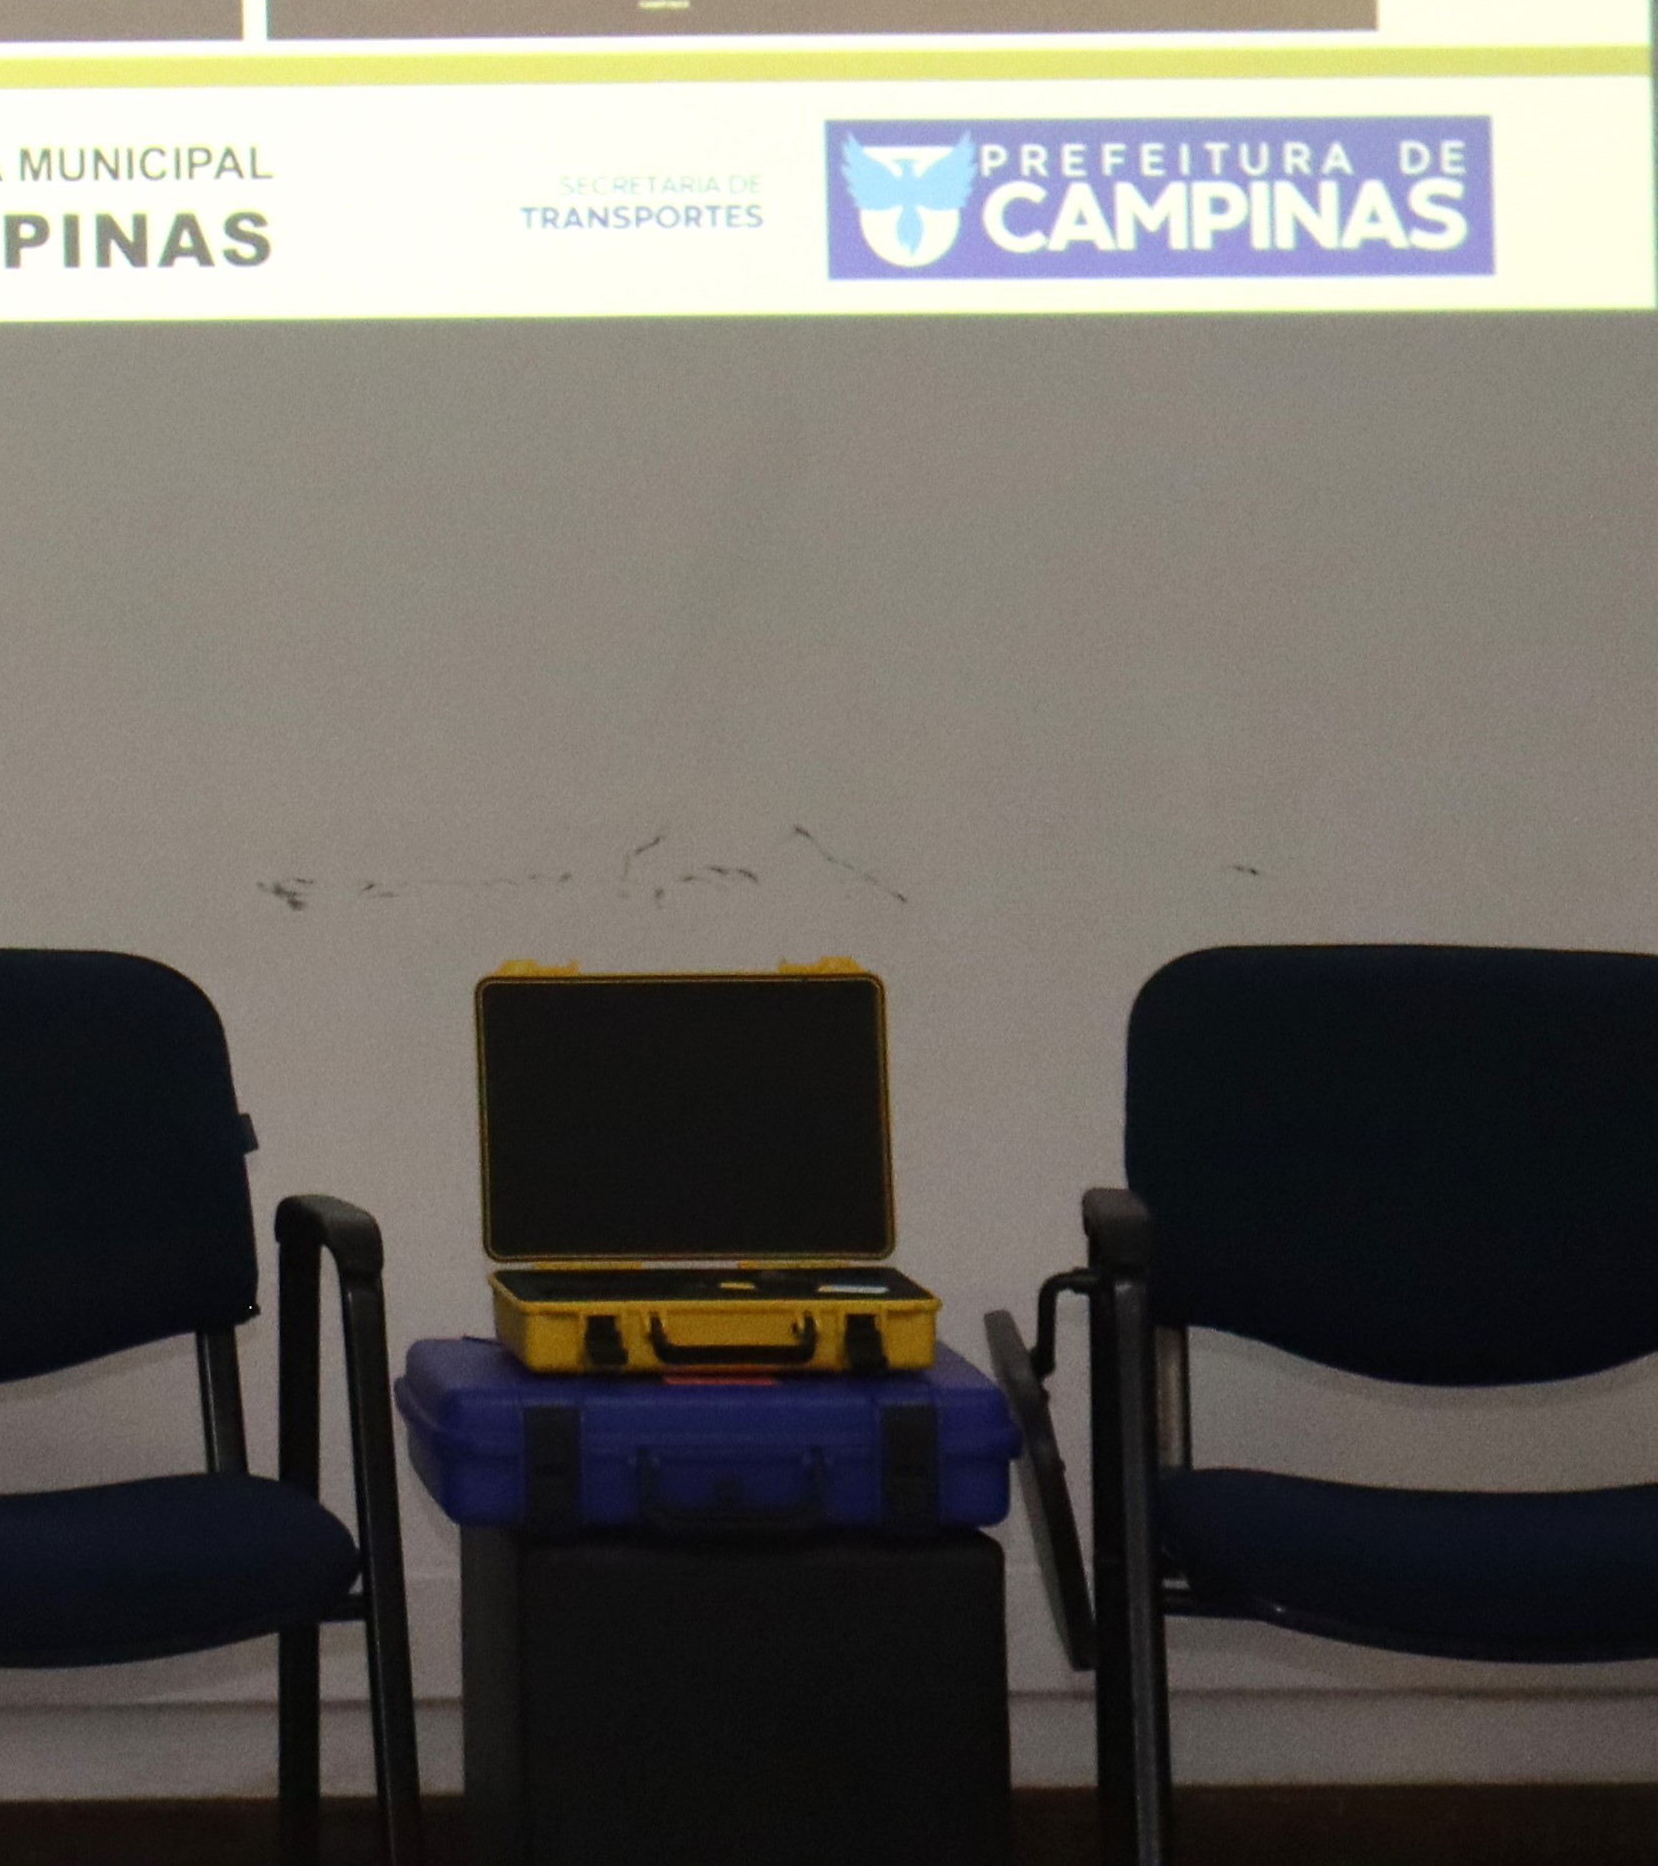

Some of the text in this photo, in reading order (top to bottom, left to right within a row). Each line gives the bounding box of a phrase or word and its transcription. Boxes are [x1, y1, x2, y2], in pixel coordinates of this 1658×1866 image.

[20, 146, 275, 182] MUNICIPAL
[979, 140, 1469, 178] PREFEITURA DE
[559, 175, 762, 196] SECRETARIA DE
[520, 205, 764, 230] TRANSPORTES
[981, 176, 1469, 254] CAMPINAS
